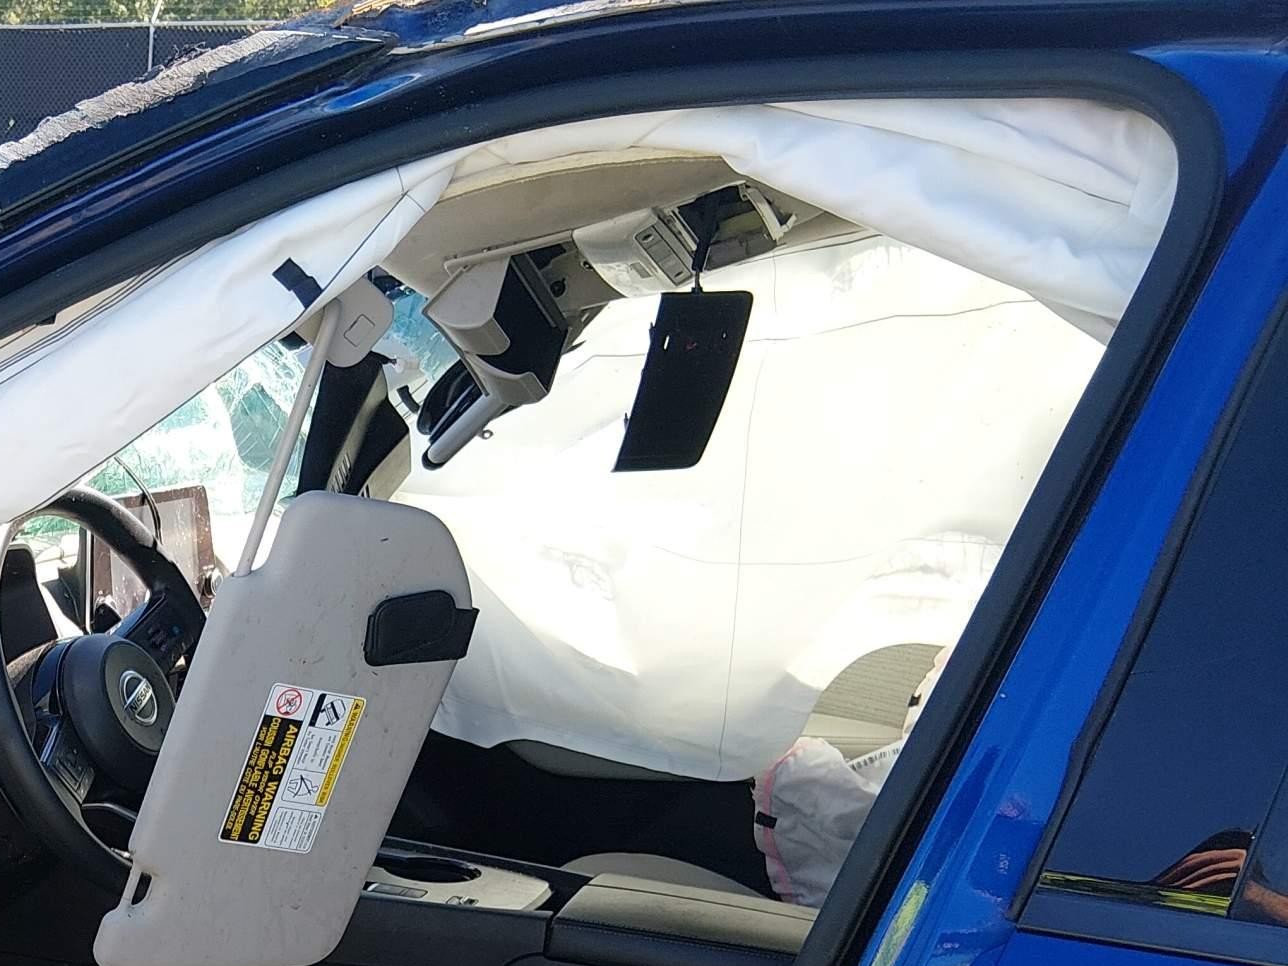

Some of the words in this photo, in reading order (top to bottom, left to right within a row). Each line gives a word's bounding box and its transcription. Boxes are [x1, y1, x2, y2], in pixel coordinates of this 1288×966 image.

[271, 723, 298, 775] AIRBAG
[256, 770, 270, 793] VISOR
[247, 780, 278, 841] WARNING
[248, 794, 261, 815] OVER
